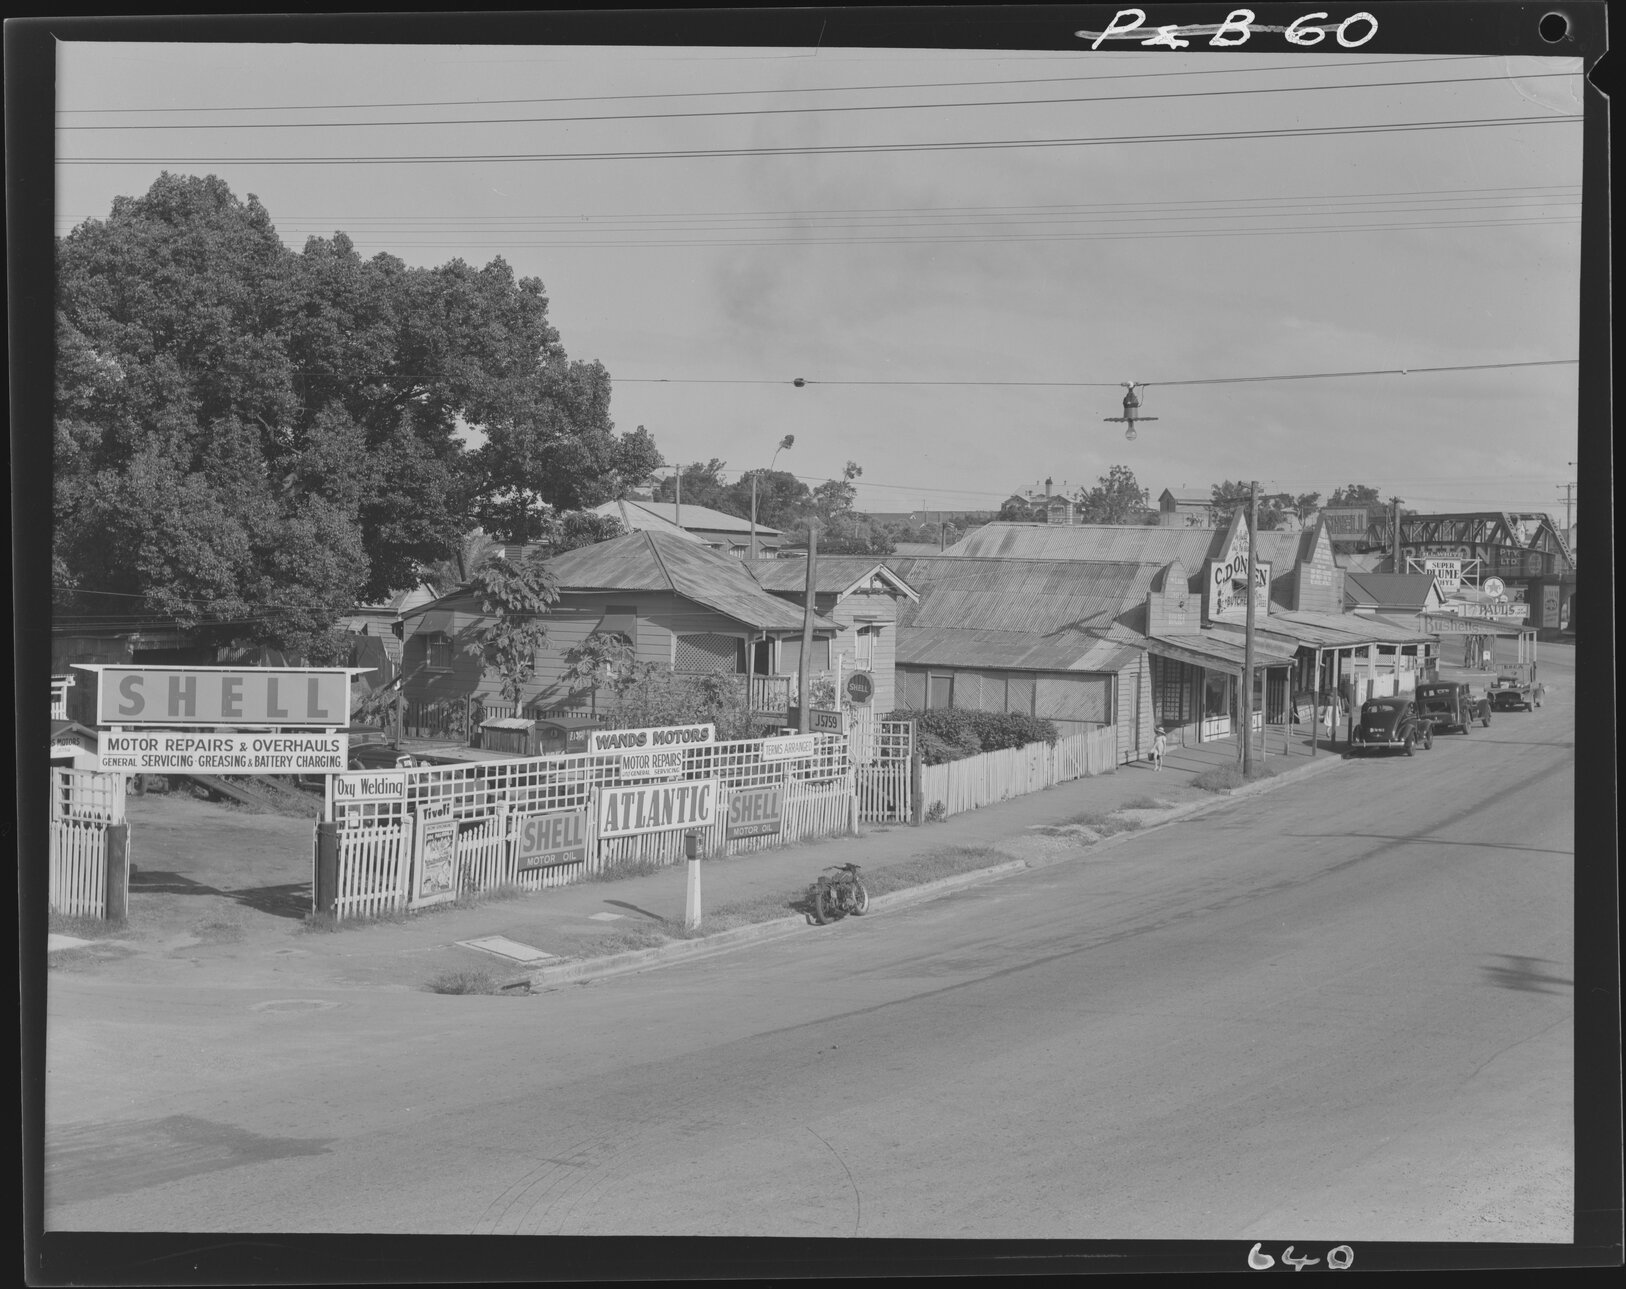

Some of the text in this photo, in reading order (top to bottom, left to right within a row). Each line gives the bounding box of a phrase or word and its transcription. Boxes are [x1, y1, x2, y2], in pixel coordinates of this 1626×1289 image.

[849, 683, 868, 693] SHELL
[117, 675, 329, 719] SHELL
[107, 738, 340, 752] MOTOR REPAIRS & OVERHAULS
[595, 731, 648, 750] WANDS
[652, 727, 710, 746] MOTORS
[765, 740, 813, 756] TERMS ARRANGED
[102, 757, 137, 767] GENERAL
[141, 754, 194, 767] SERVICING
[198, 755, 247, 768] GREASING
[247, 758, 253, 767] &
[254, 755, 293, 768] BATTERY
[622, 752, 682, 770] MOTOR REPAIRS
[631, 769, 650, 777] GENERAL
[337, 777, 403, 798] Oxy Welding
[423, 803, 450, 820] Tivoli
[603, 784, 711, 832] ATLANTIC
[730, 793, 779, 823] SHELL
[523, 815, 583, 853] SHELL
[733, 824, 773, 835] MOTOR OIL
[527, 851, 577, 866] MOTOR OIL
[1248, 1242, 1354, 1272] 640
